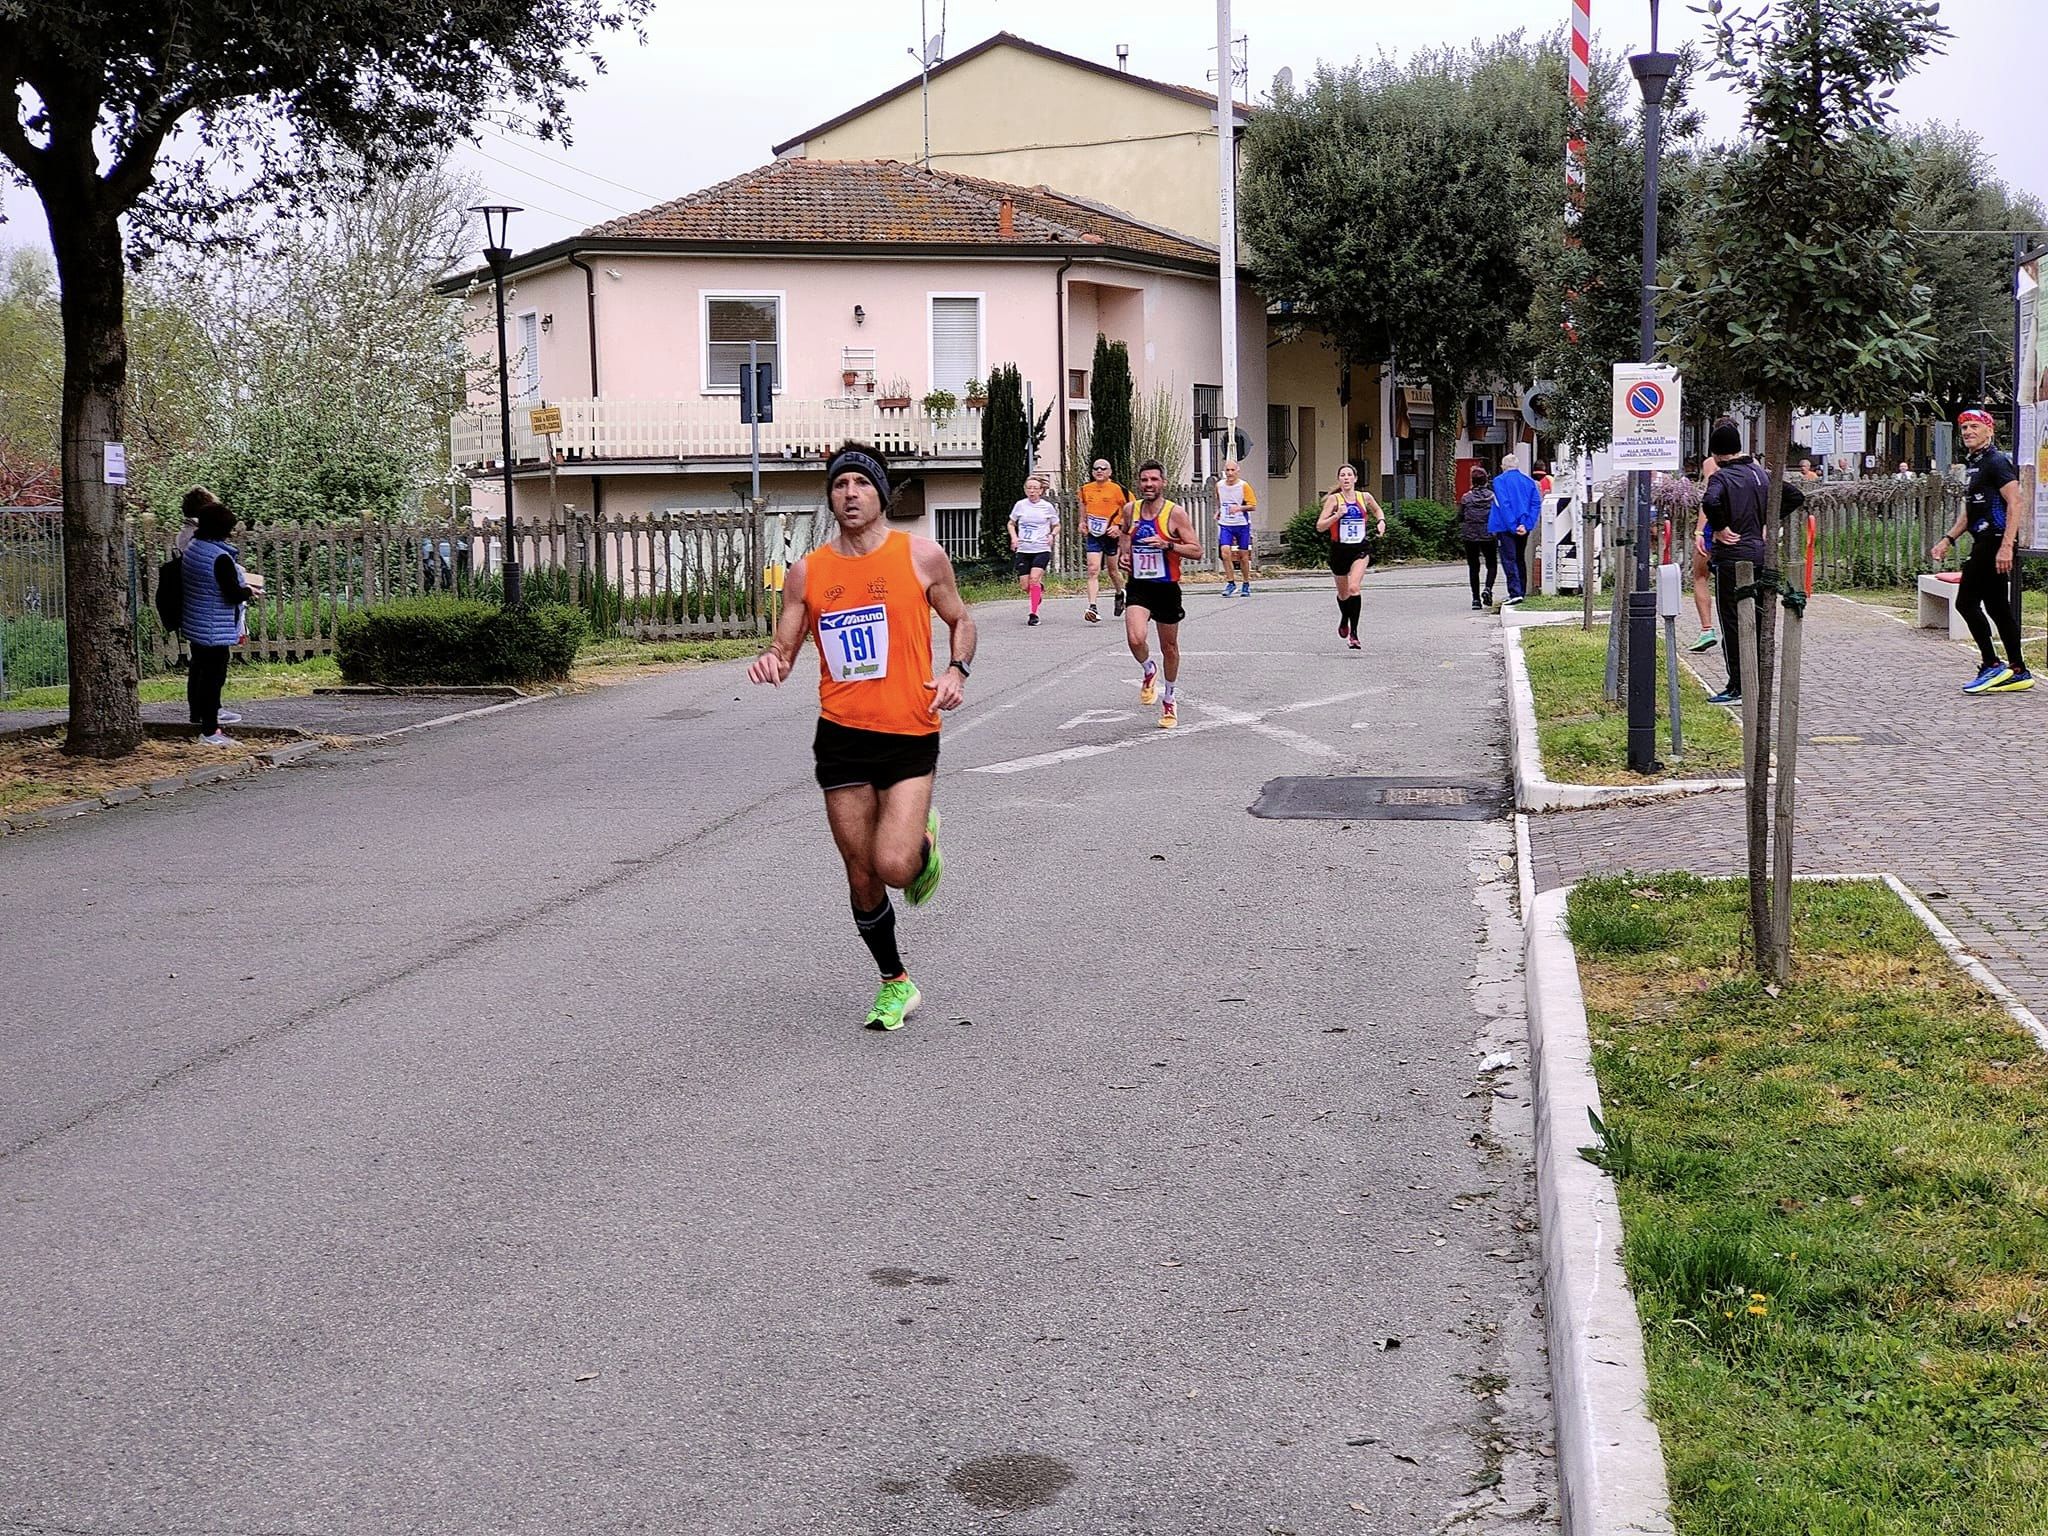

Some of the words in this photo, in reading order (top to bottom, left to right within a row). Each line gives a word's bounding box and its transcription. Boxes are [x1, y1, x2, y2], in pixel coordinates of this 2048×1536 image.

[1347, 525, 1357, 537] 54
[1139, 554, 1157, 569] 271
[839, 626, 876, 663] 191
